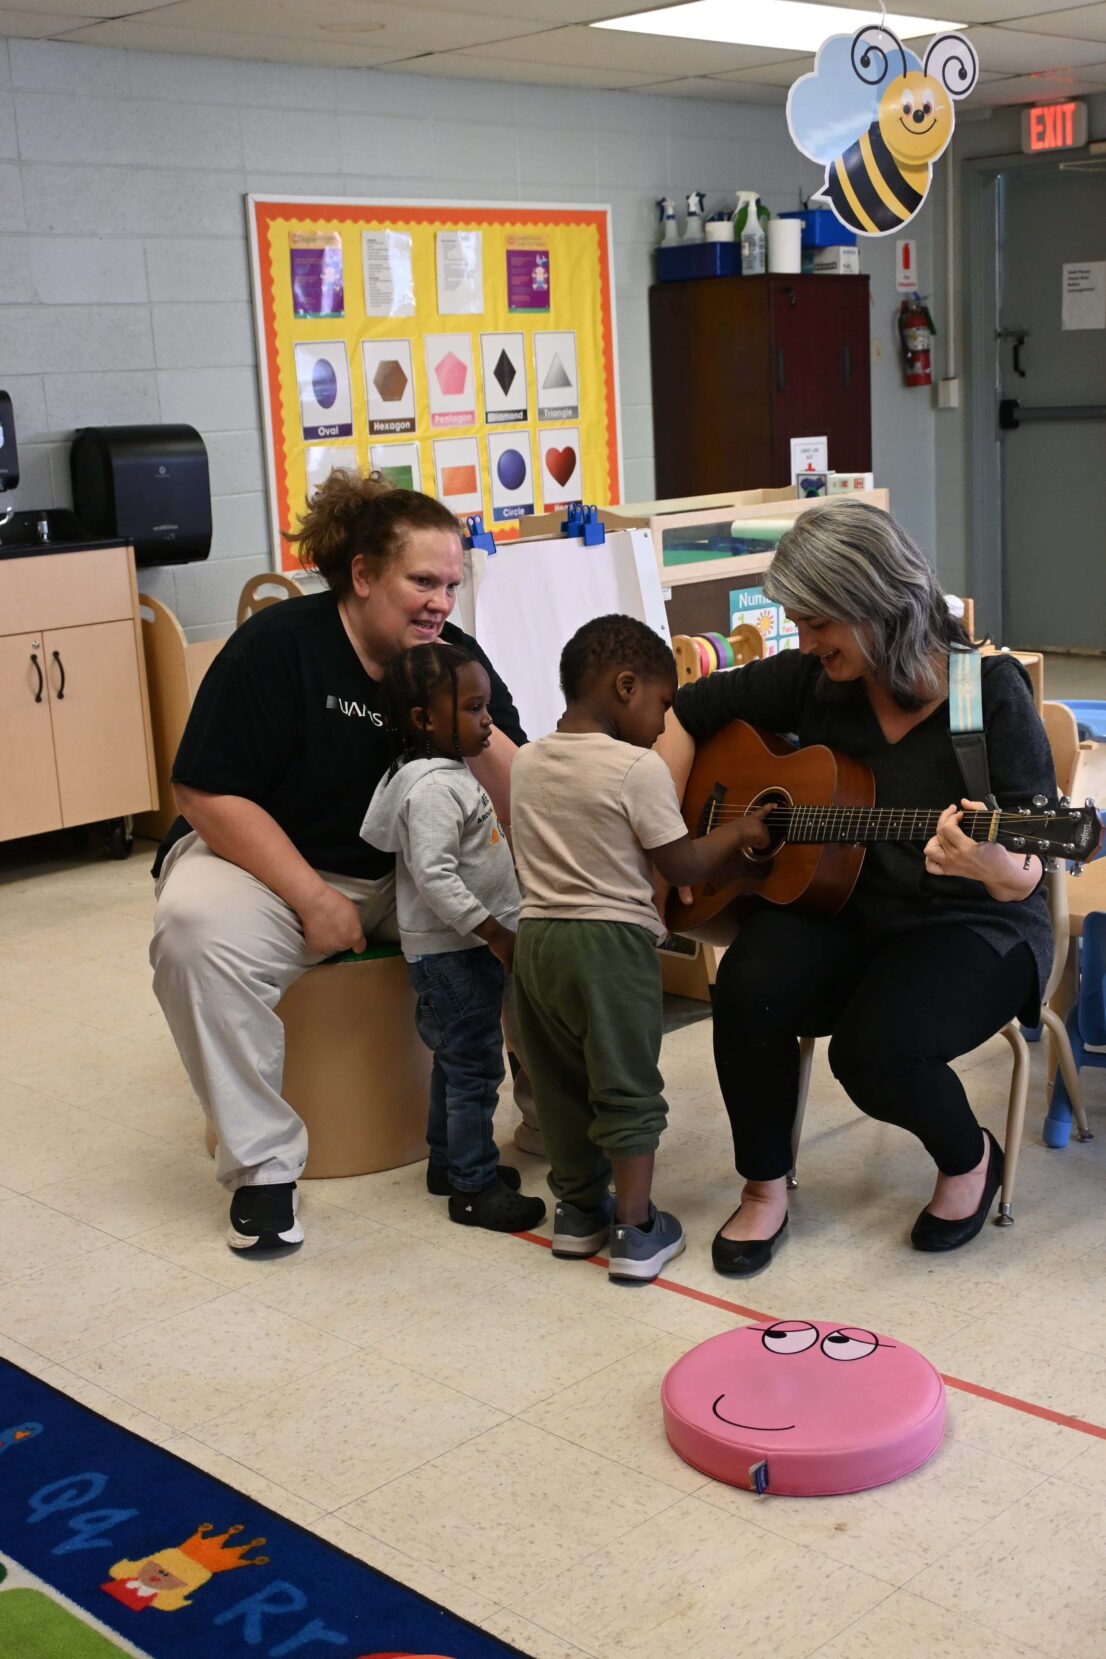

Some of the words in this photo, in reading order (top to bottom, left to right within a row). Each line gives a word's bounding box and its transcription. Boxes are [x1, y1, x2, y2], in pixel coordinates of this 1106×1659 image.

[1029, 102, 1076, 151] EXIT
[434, 413, 472, 424] Pentagon
[543, 408, 573, 418] Triangle
[318, 426, 339, 437] Oval
[373, 421, 411, 432] Hexagon
[502, 507, 525, 517] Circle
[739, 592, 773, 608] Num
[1080, 821, 1092, 847] Taylor
